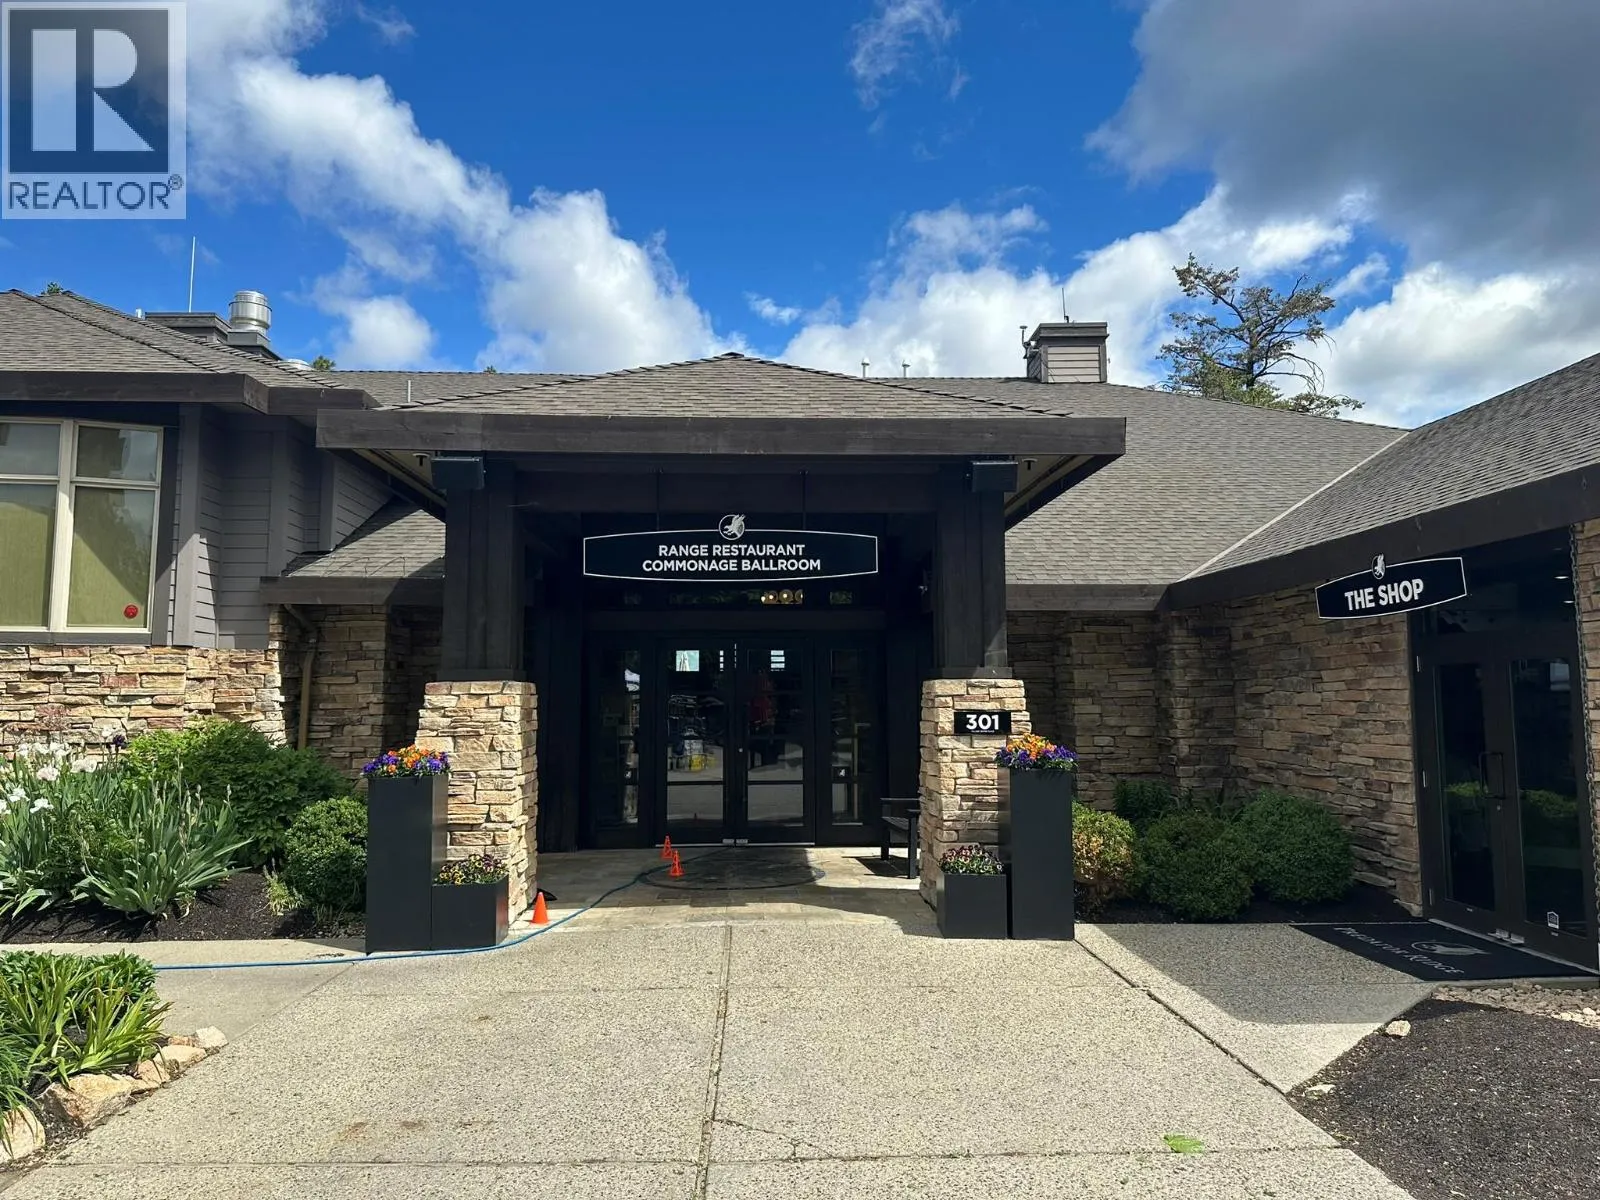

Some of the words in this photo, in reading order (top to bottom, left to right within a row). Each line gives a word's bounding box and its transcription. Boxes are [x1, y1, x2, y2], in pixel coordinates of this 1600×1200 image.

[658, 545, 708, 556] RANGE
[712, 544, 805, 556] RESTAURANT
[642, 559, 738, 571] COMMONAGE
[742, 559, 821, 571] BALLROOM
[1344, 588, 1375, 611] THE
[1378, 578, 1424, 606] SHOP
[966, 714, 999, 730] 301
